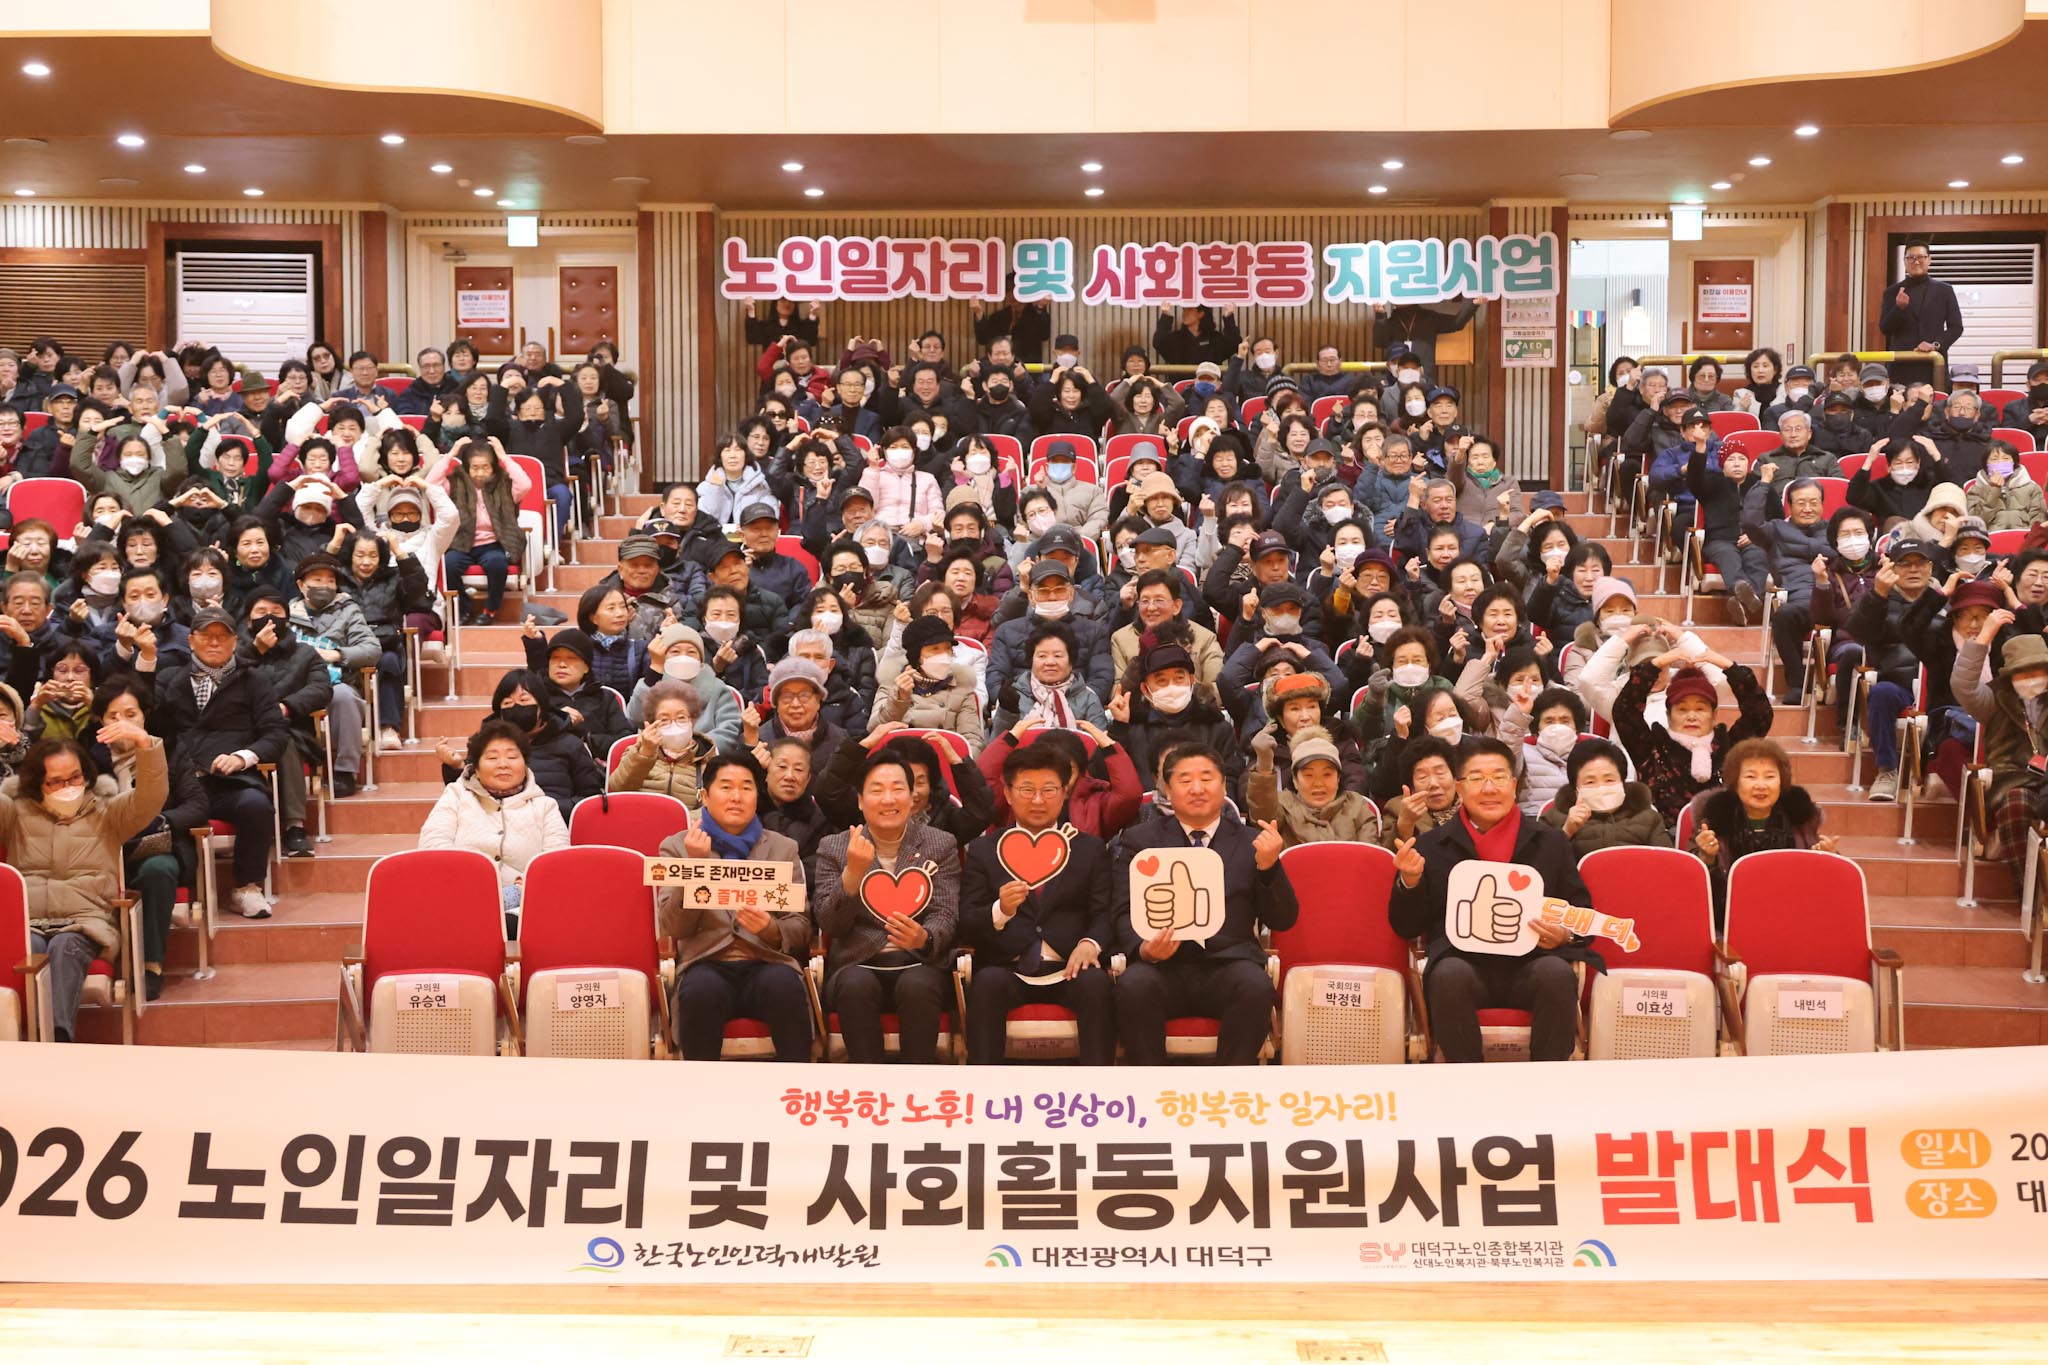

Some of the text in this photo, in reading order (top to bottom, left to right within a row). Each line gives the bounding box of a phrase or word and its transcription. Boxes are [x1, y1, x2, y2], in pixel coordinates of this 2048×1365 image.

[724, 235, 1553, 301] 노인일자리 및 사회활동 지원사업
[1522, 342, 1543, 350] AED
[669, 864, 776, 882] 오늘도 존재만으로
[717, 888, 758, 906] 즐거움
[414, 983, 441, 993] 구의원
[575, 982, 601, 993] 구의원
[1328, 981, 1361, 992] 국회의원
[408, 994, 447, 1008] 유승연
[570, 993, 608, 1007] 양영자
[1325, 993, 1361, 1008] 박정현
[1642, 990, 1668, 1000] 시의원
[1636, 1000, 1674, 1015] 이효성
[1794, 999, 1827, 1011] 내빈석
[780, 1088, 1397, 1128] 행복한 노후! 내 일상이, 행복한 일자리!
[1915, 1131, 1979, 1166] 일시
[178, 1132, 649, 1228] 노인일자리
[688, 1141, 770, 1230] 및
[807, 1134, 1559, 1231] 사회활동지원사업
[1595, 1126, 1875, 1225] 발대식
[1919, 1181, 1985, 1217] 장소
[634, 1242, 881, 1267] 한국노인인력개발원
[1032, 1246, 1273, 1267] 대전광역시 대덕구
[1411, 1241, 1563, 1257] 대덕구노인종합복지관
